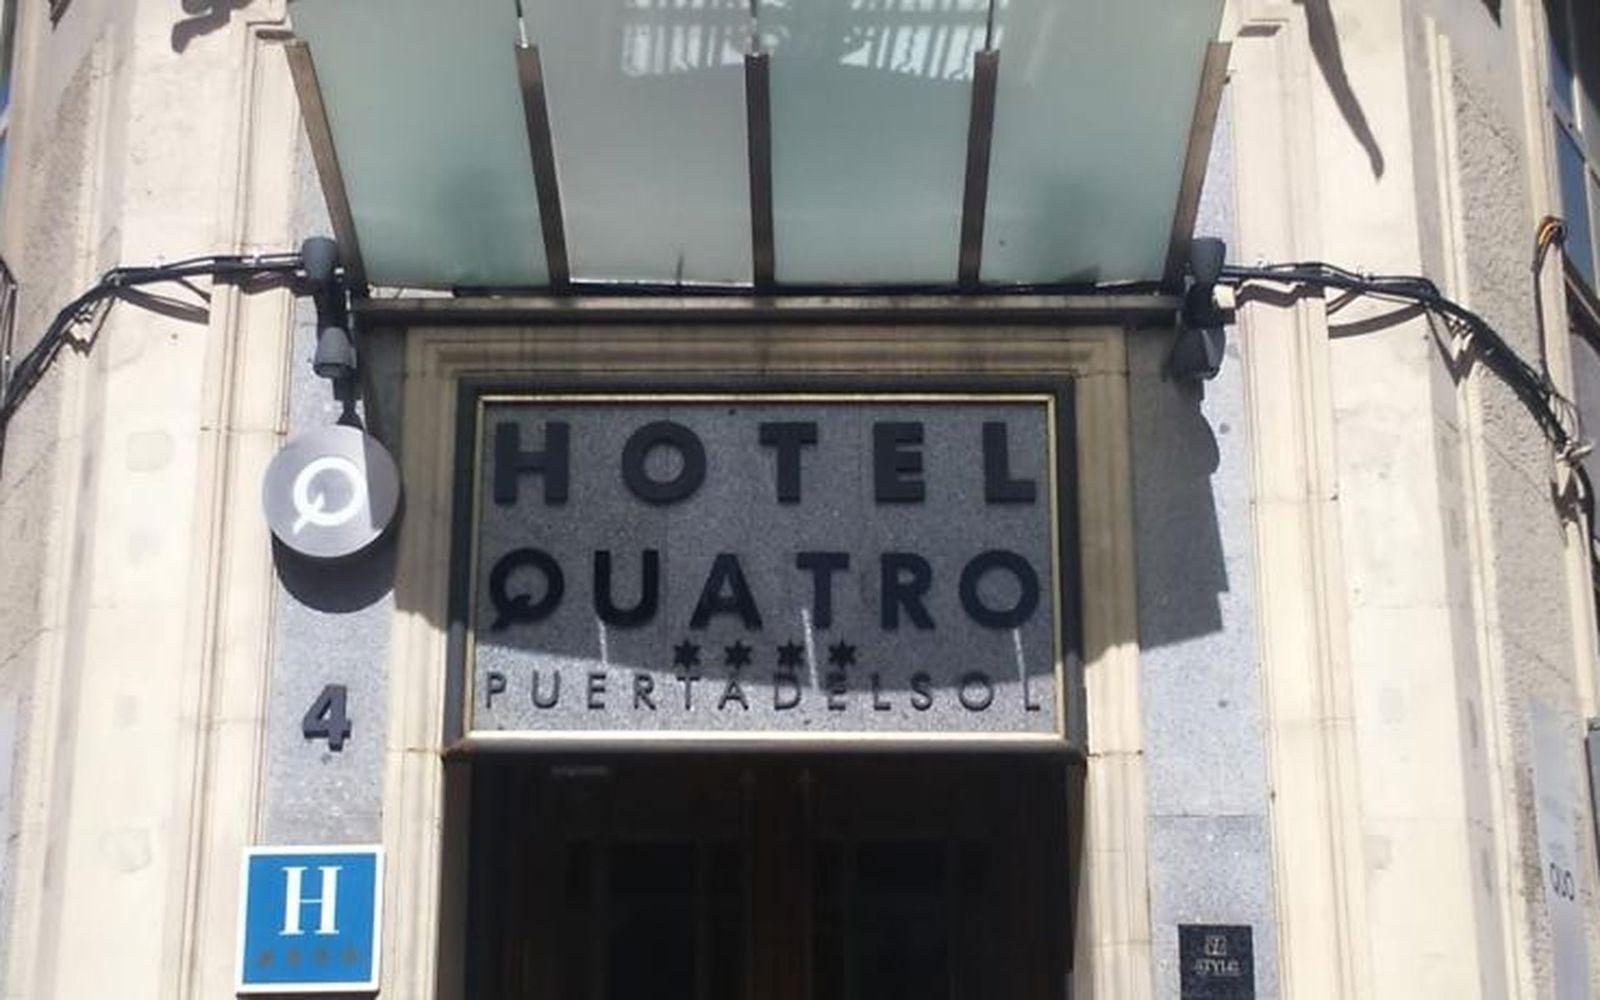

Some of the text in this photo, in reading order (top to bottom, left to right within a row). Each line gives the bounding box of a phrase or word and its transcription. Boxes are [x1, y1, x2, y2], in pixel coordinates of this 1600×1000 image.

[293, 456, 366, 534] Q
[493, 421, 1037, 505] HOTEL
[488, 547, 1041, 631] QUATRO
[302, 684, 351, 752] 4
[278, 866, 342, 936] H
